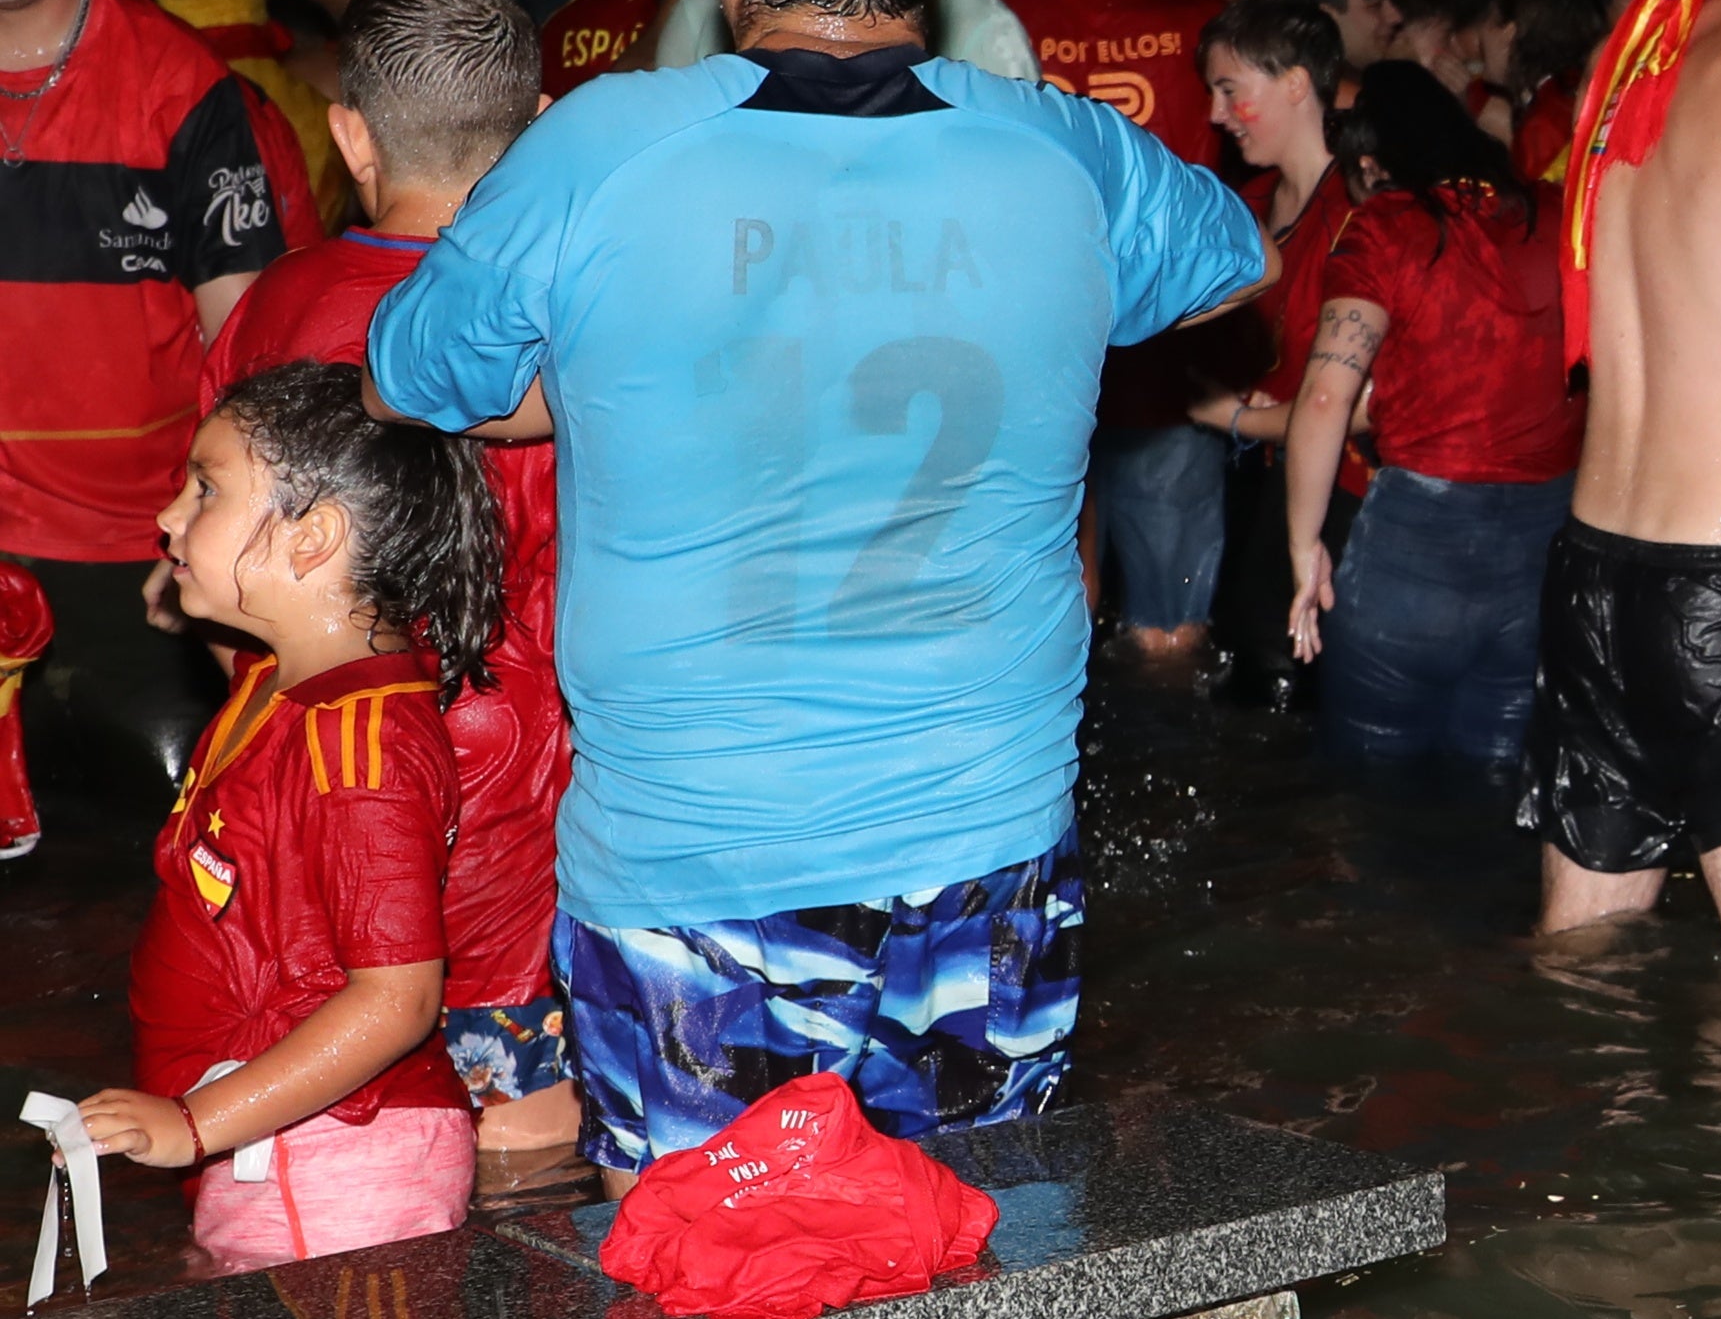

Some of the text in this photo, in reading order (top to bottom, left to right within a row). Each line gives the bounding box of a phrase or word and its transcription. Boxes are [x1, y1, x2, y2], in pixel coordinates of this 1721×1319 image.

[1096, 32, 1182, 64] ELLOS!
[731, 216, 983, 295] PAULA
[697, 335, 1003, 645] 12
[192, 845, 232, 883] ESPAÑA
